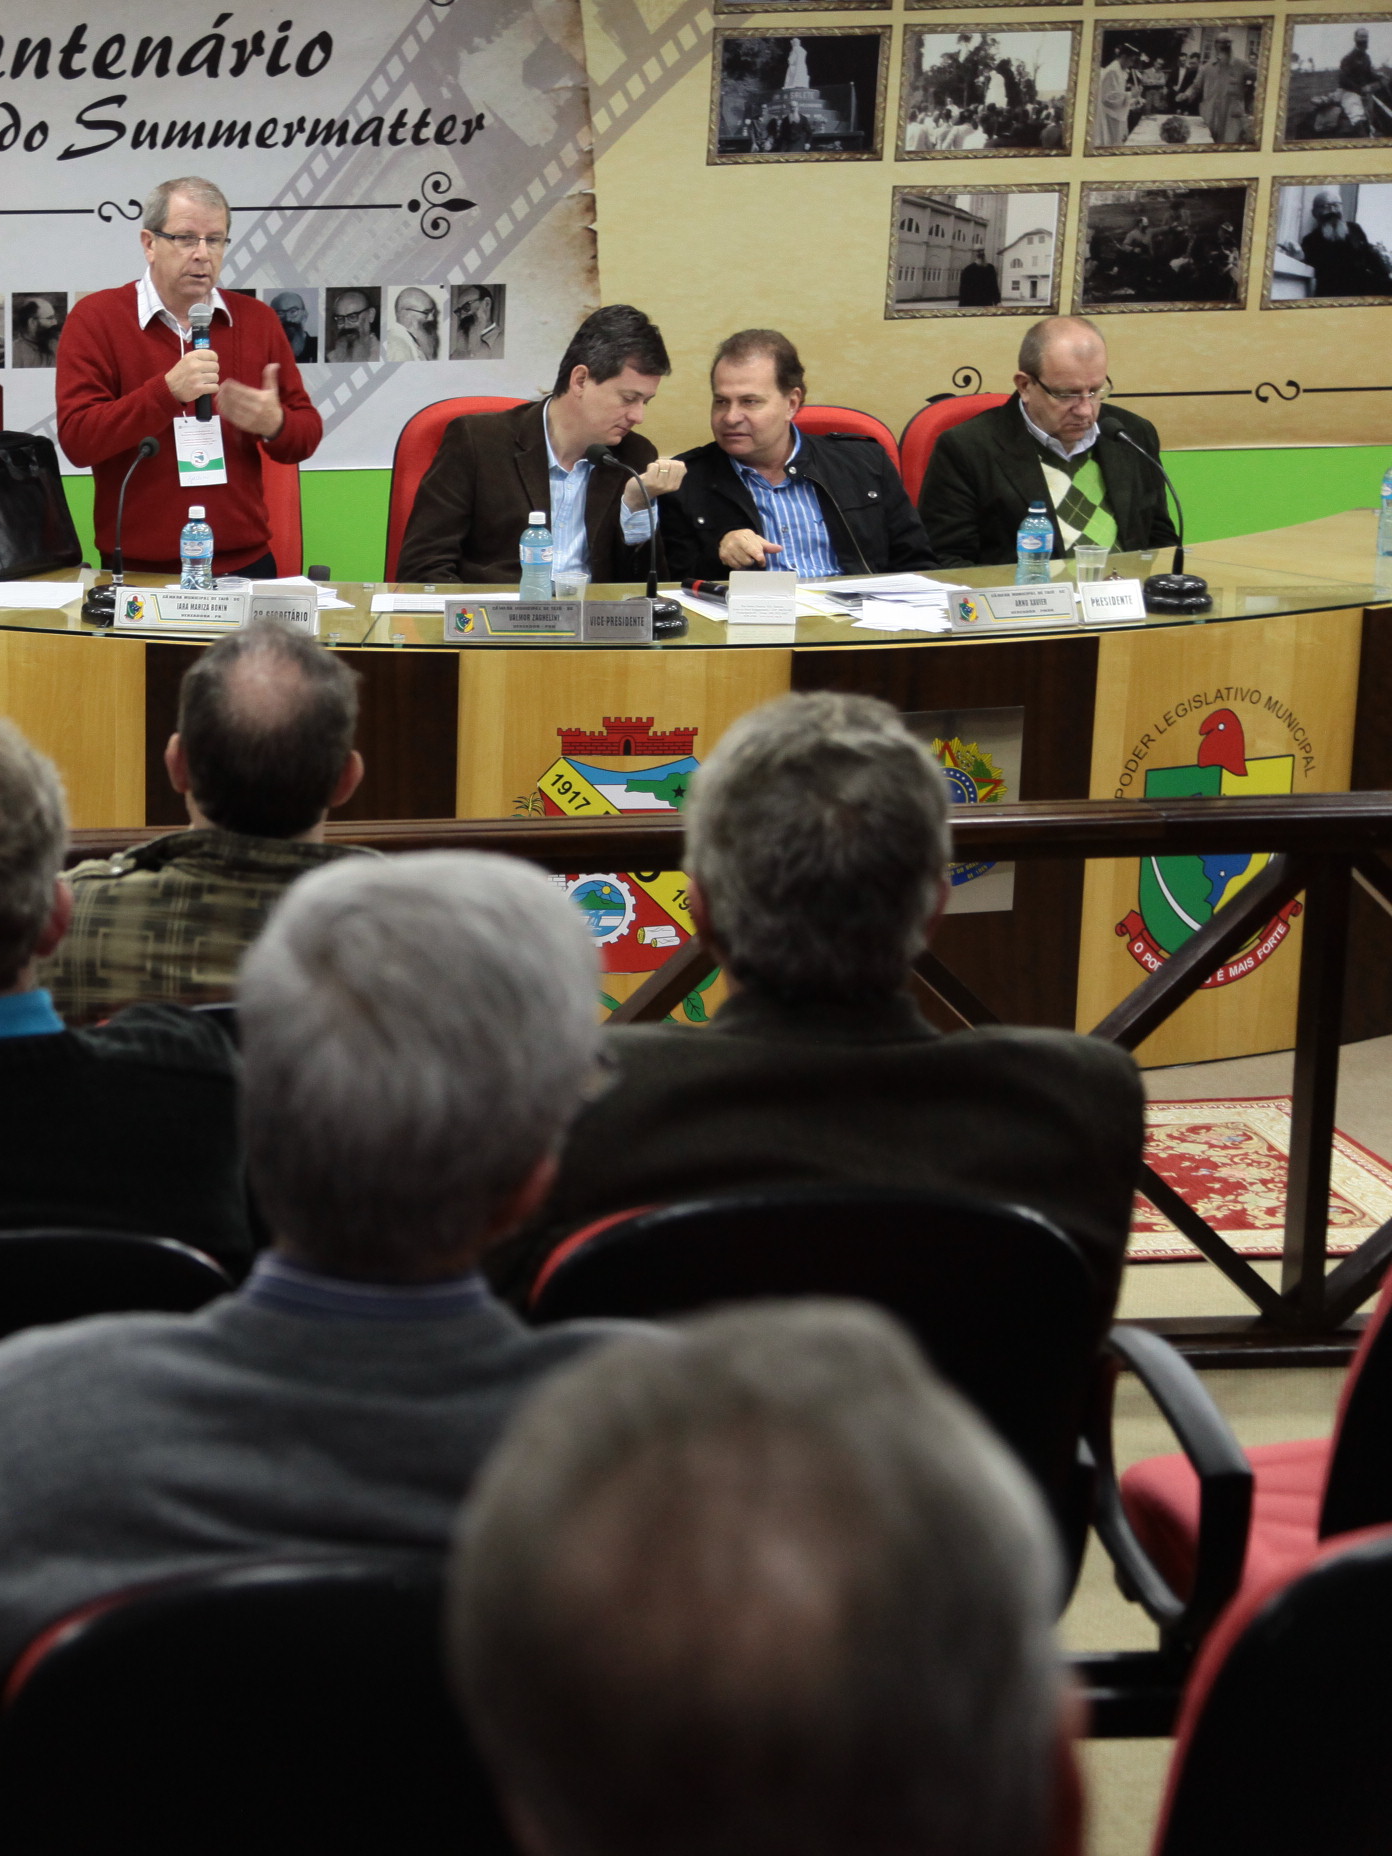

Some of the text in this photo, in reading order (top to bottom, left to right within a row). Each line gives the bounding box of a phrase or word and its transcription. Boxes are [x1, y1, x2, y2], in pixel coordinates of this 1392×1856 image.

[56, 94, 486, 161] Summermatter
[1090, 594, 1133, 608] PRESIDENTE
[1114, 686, 1317, 799] PODER LEGISLATIVO MUNICIPAL
[551, 774, 591, 810] 1917
[672, 889, 692, 911] 19
[1217, 922, 1287, 981] É MAIS FORTE
